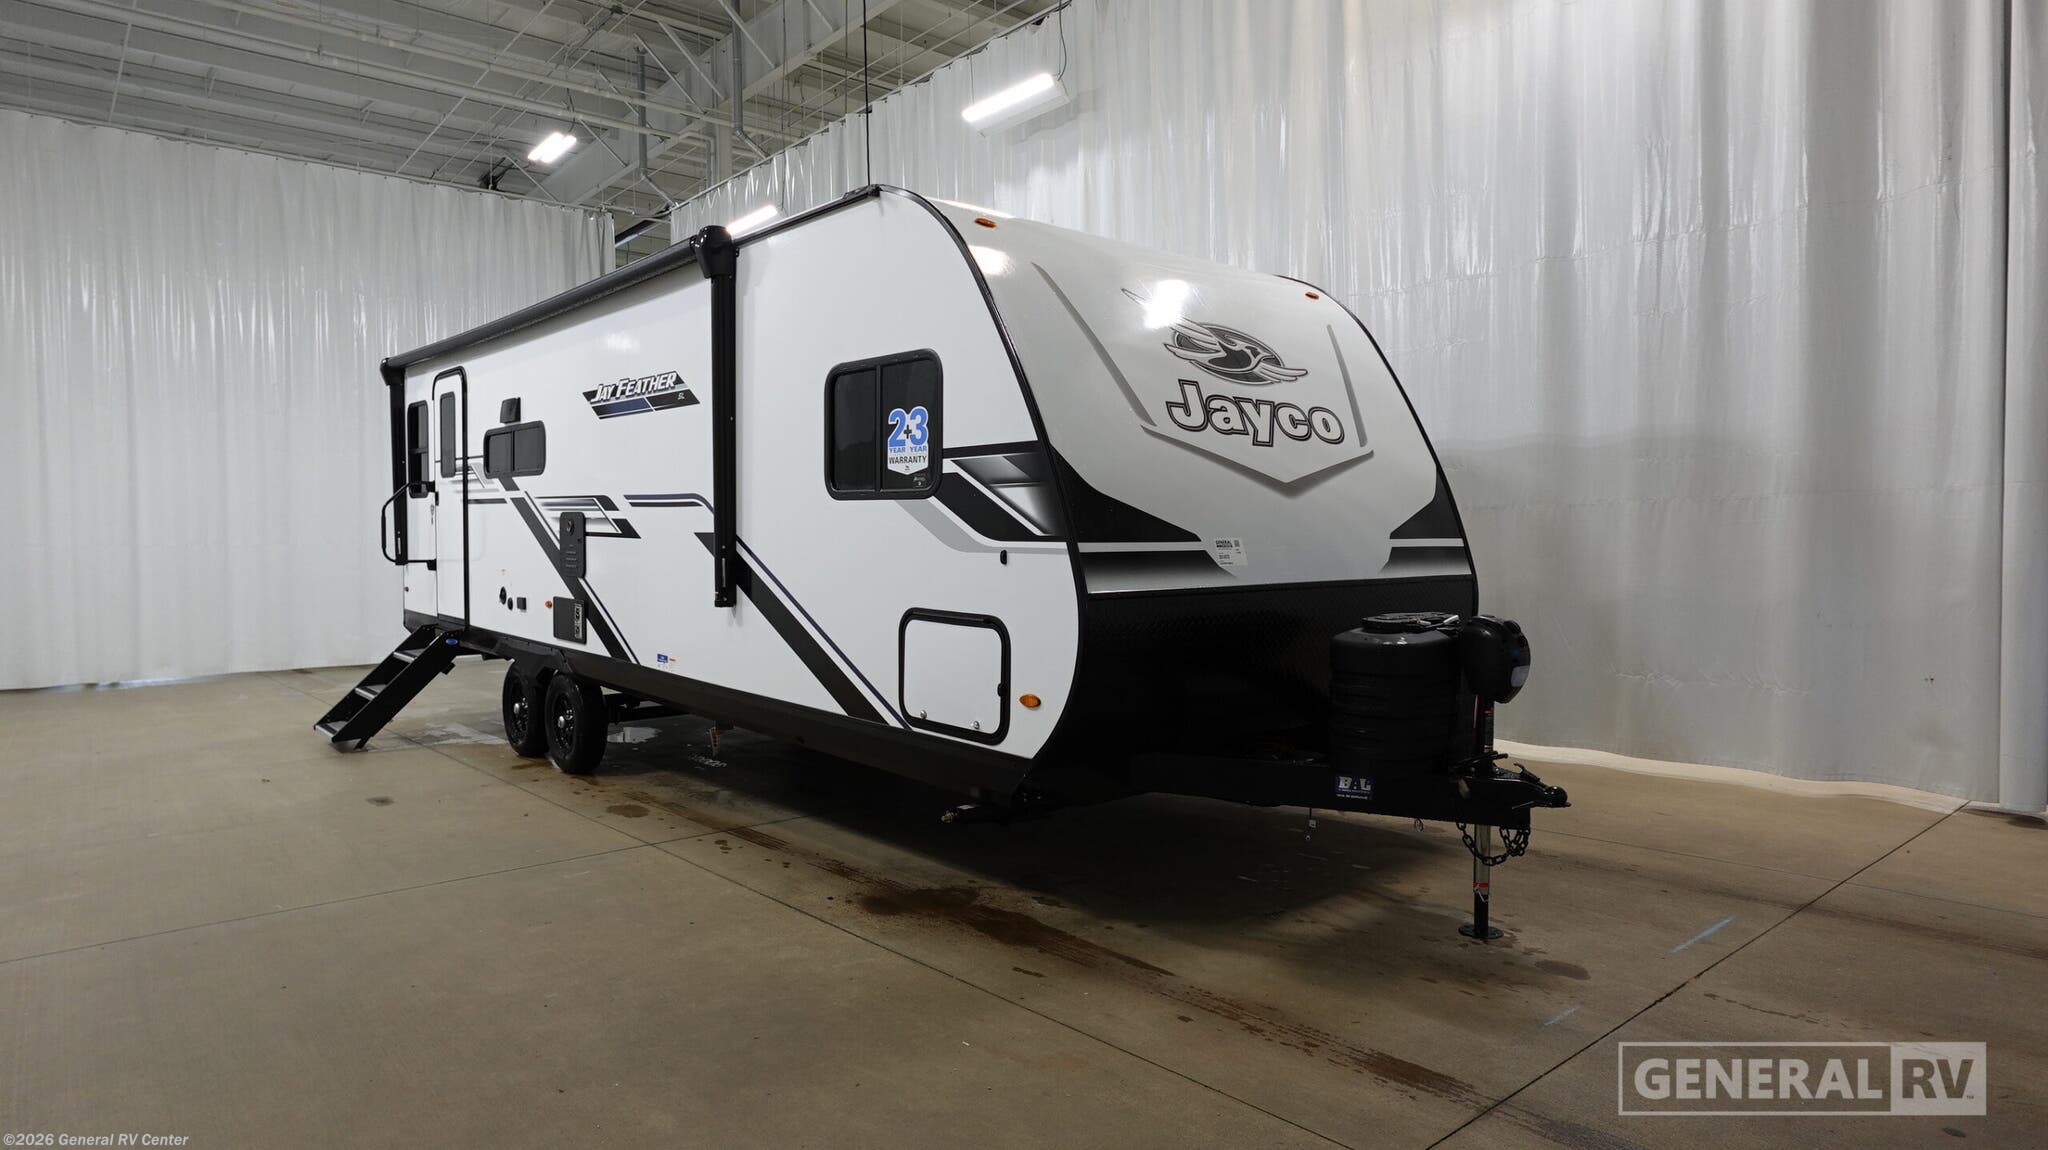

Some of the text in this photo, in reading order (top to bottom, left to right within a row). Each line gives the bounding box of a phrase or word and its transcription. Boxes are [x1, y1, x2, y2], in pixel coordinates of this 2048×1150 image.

[590, 371, 678, 404] JAY FEATHER
[1166, 379, 1345, 447] Jayco
[889, 455, 927, 464] WARRANTY
